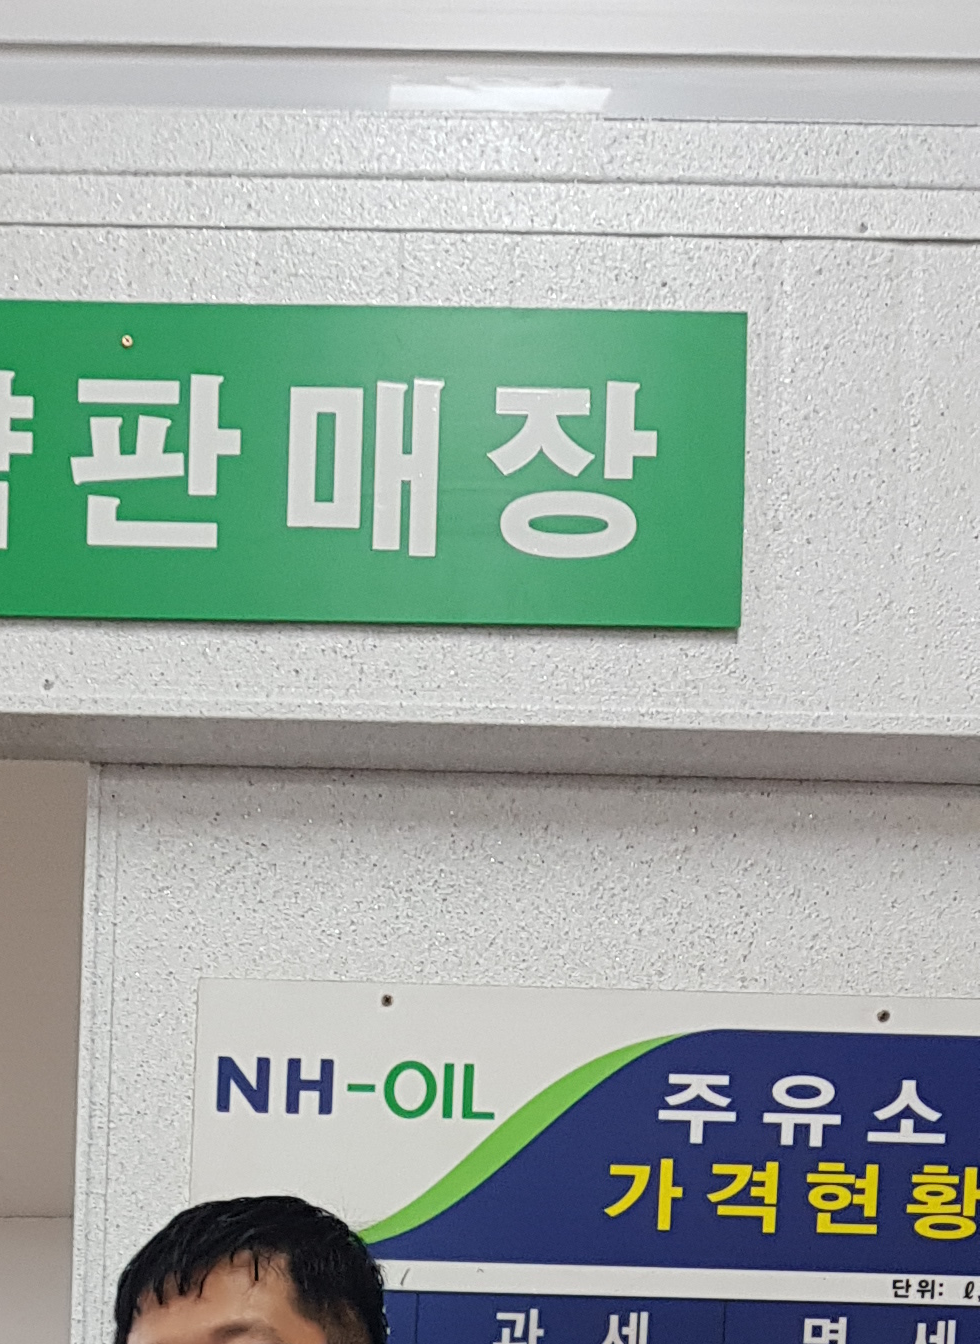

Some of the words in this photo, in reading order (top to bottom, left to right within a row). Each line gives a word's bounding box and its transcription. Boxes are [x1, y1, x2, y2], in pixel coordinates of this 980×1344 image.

[216, 1055, 495, 1120] NH-OIL
[657, 1073, 946, 1147] 주유소
[604, 1158, 980, 1240] 가격현황
